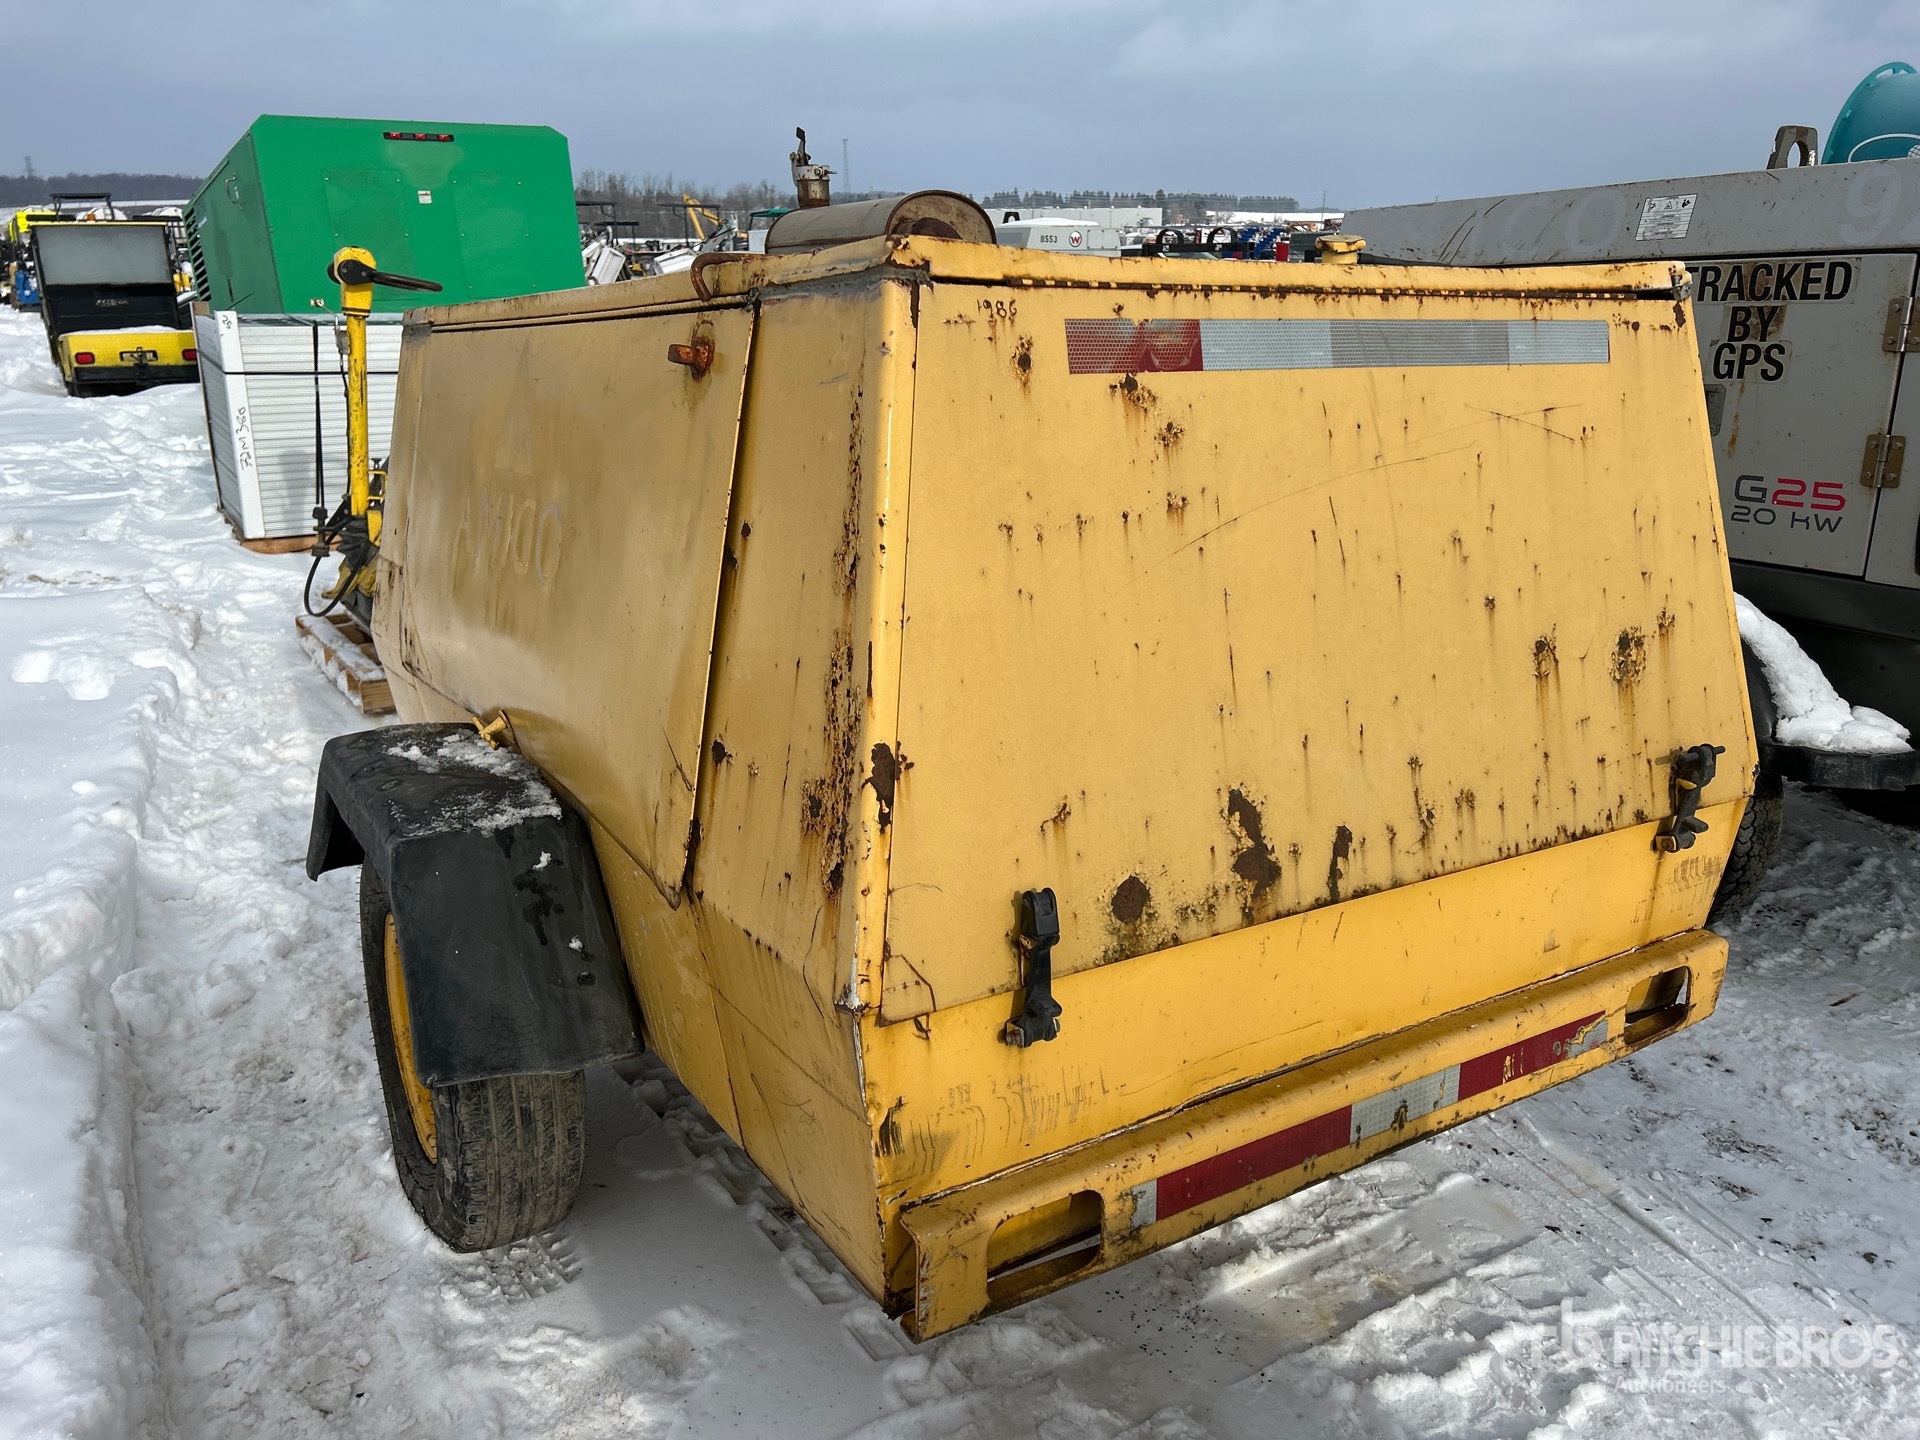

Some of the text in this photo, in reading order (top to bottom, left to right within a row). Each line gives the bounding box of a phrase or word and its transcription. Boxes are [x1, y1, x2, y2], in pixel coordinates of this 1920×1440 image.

[1040, 235, 1058, 243] 11553
[1727, 304, 1780, 343] BY
[1712, 343, 1786, 382] GPS
[1734, 474, 1847, 512] G25
[1731, 505, 1777, 526] 20
